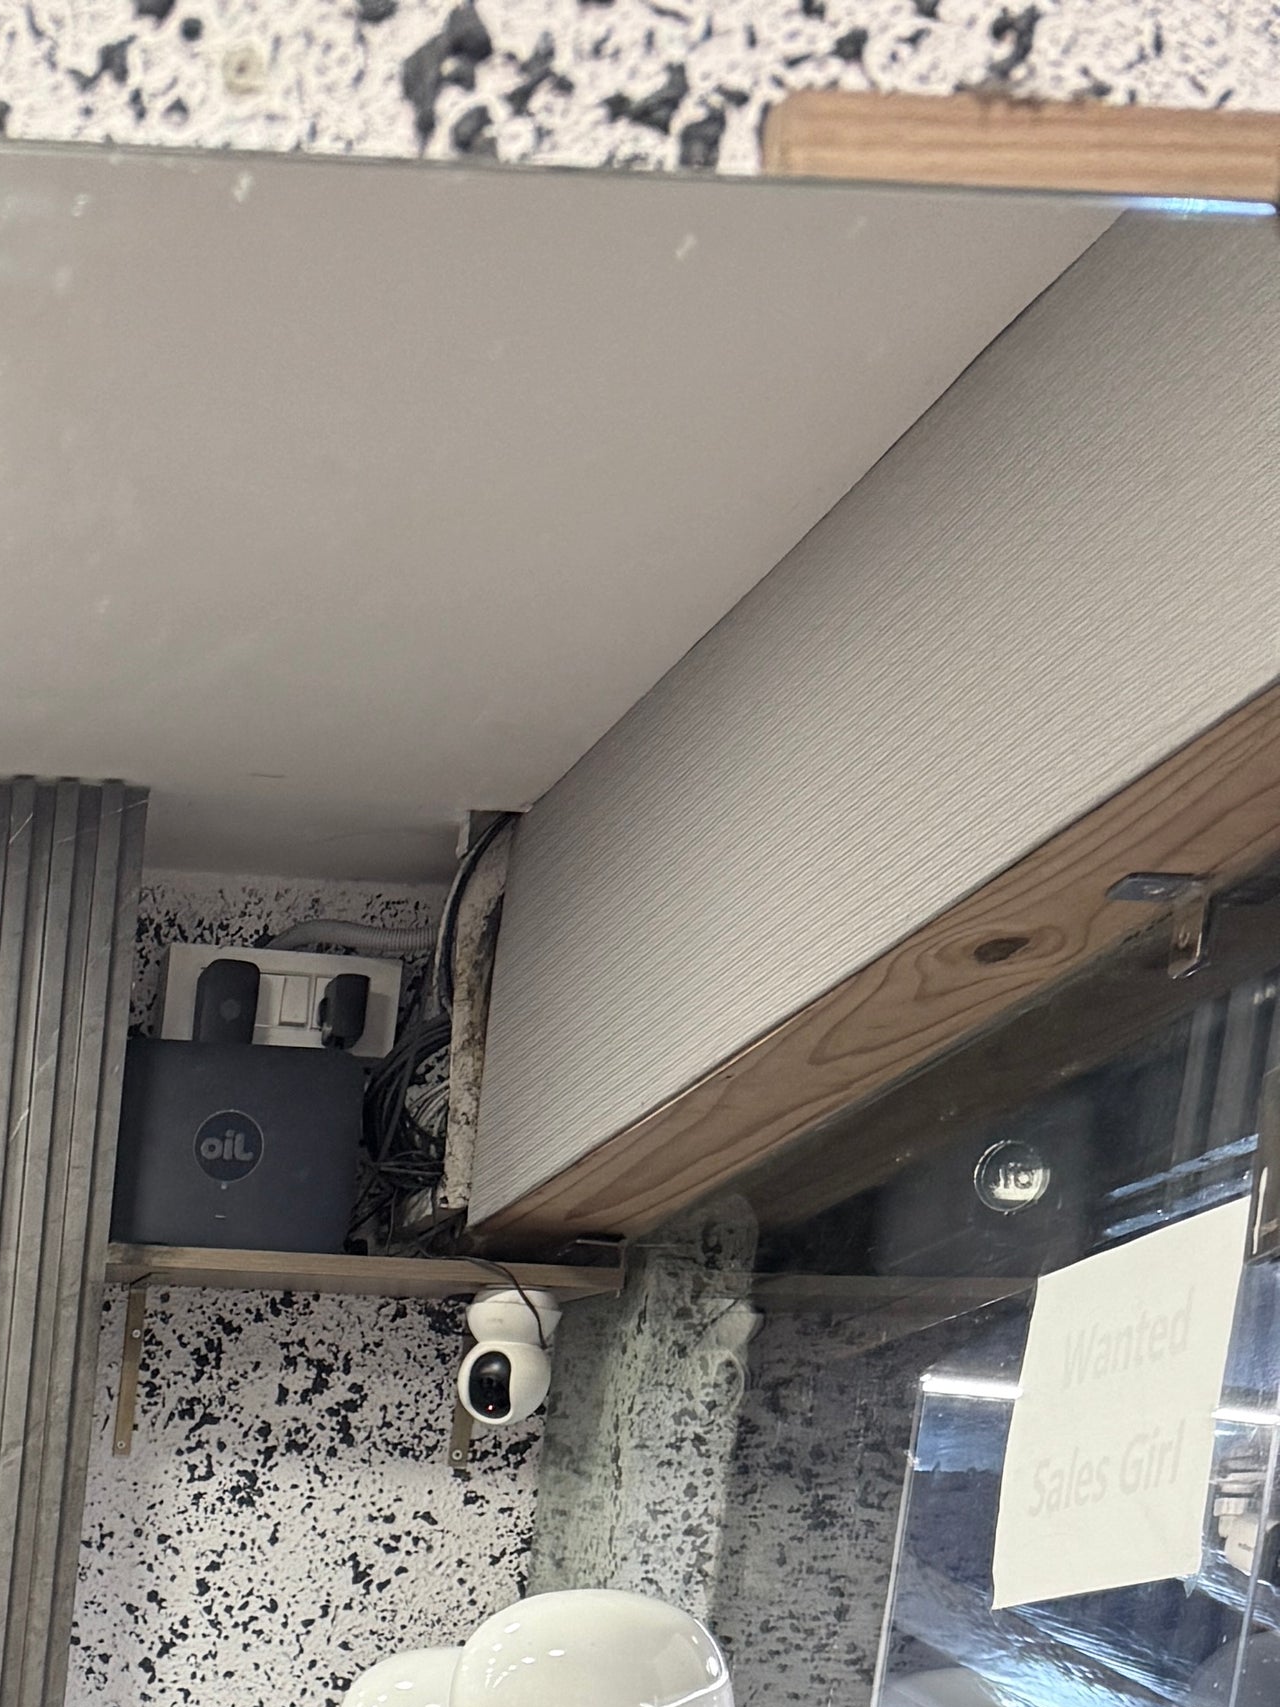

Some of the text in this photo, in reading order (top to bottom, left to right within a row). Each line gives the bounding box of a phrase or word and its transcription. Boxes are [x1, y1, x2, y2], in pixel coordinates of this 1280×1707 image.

[1060, 1286, 1196, 1391] Wanted
[1026, 1420, 1187, 1518] Sales Girl
